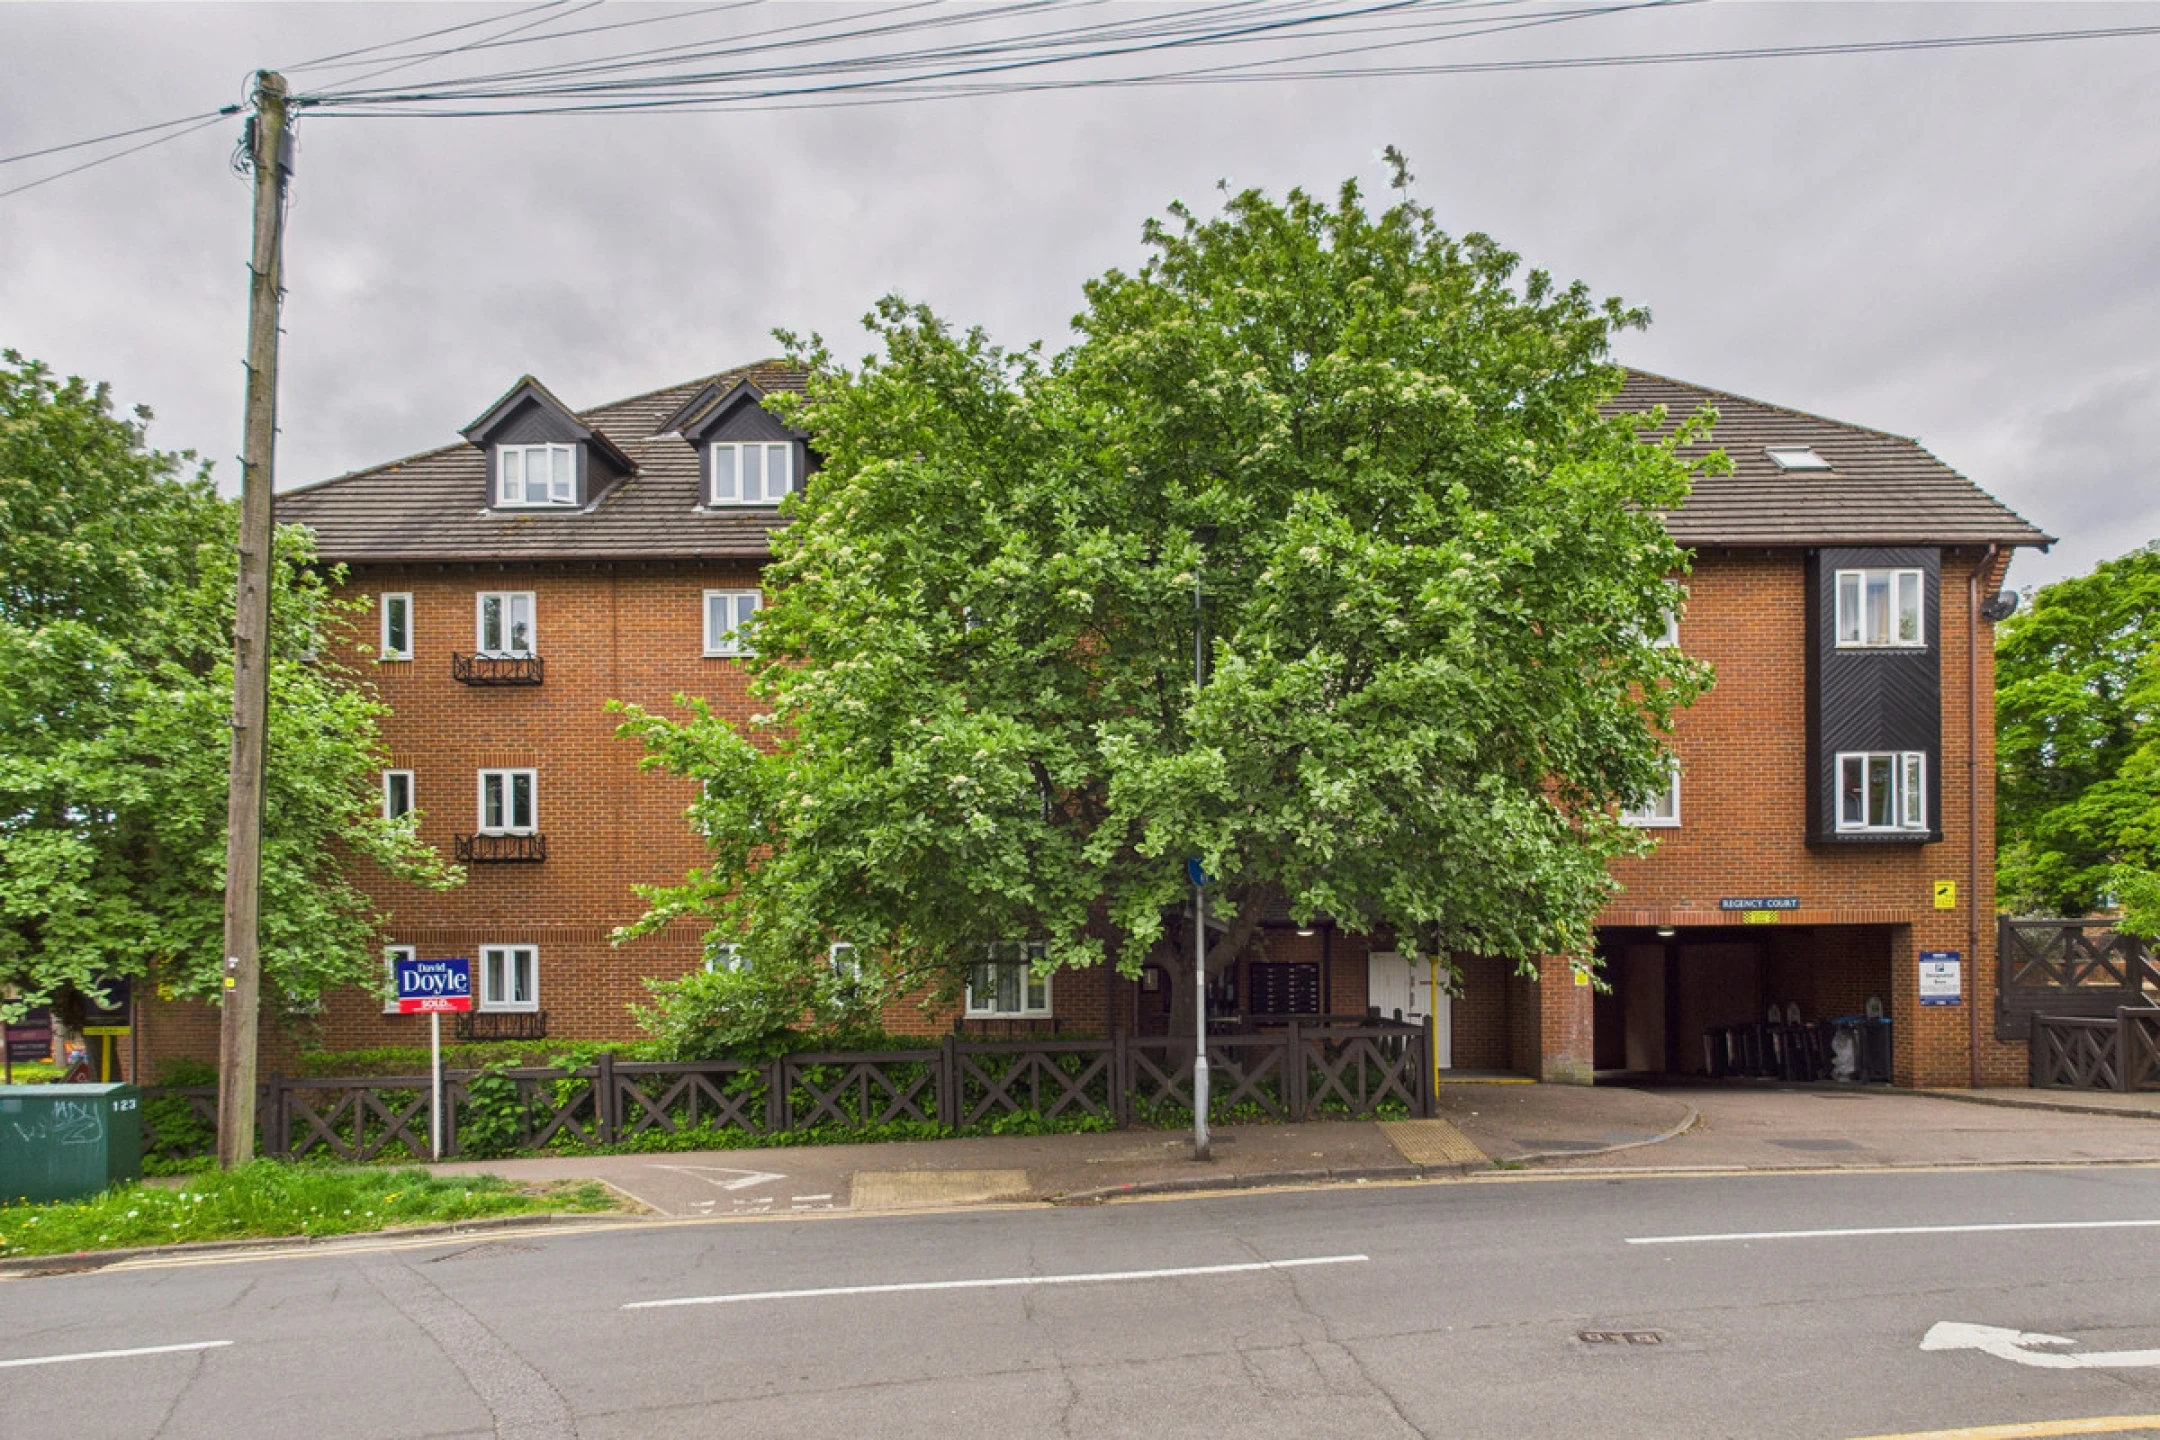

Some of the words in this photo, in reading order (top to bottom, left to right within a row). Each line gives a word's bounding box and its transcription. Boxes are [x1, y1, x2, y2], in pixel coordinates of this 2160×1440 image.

[1722, 899, 1762, 908] REGENCY
[1767, 899, 1798, 908] COURT
[417, 963, 445, 972] David
[403, 968, 467, 994] Doyle
[421, 999, 448, 1008] SOLD
[112, 1099, 136, 1111] 123
